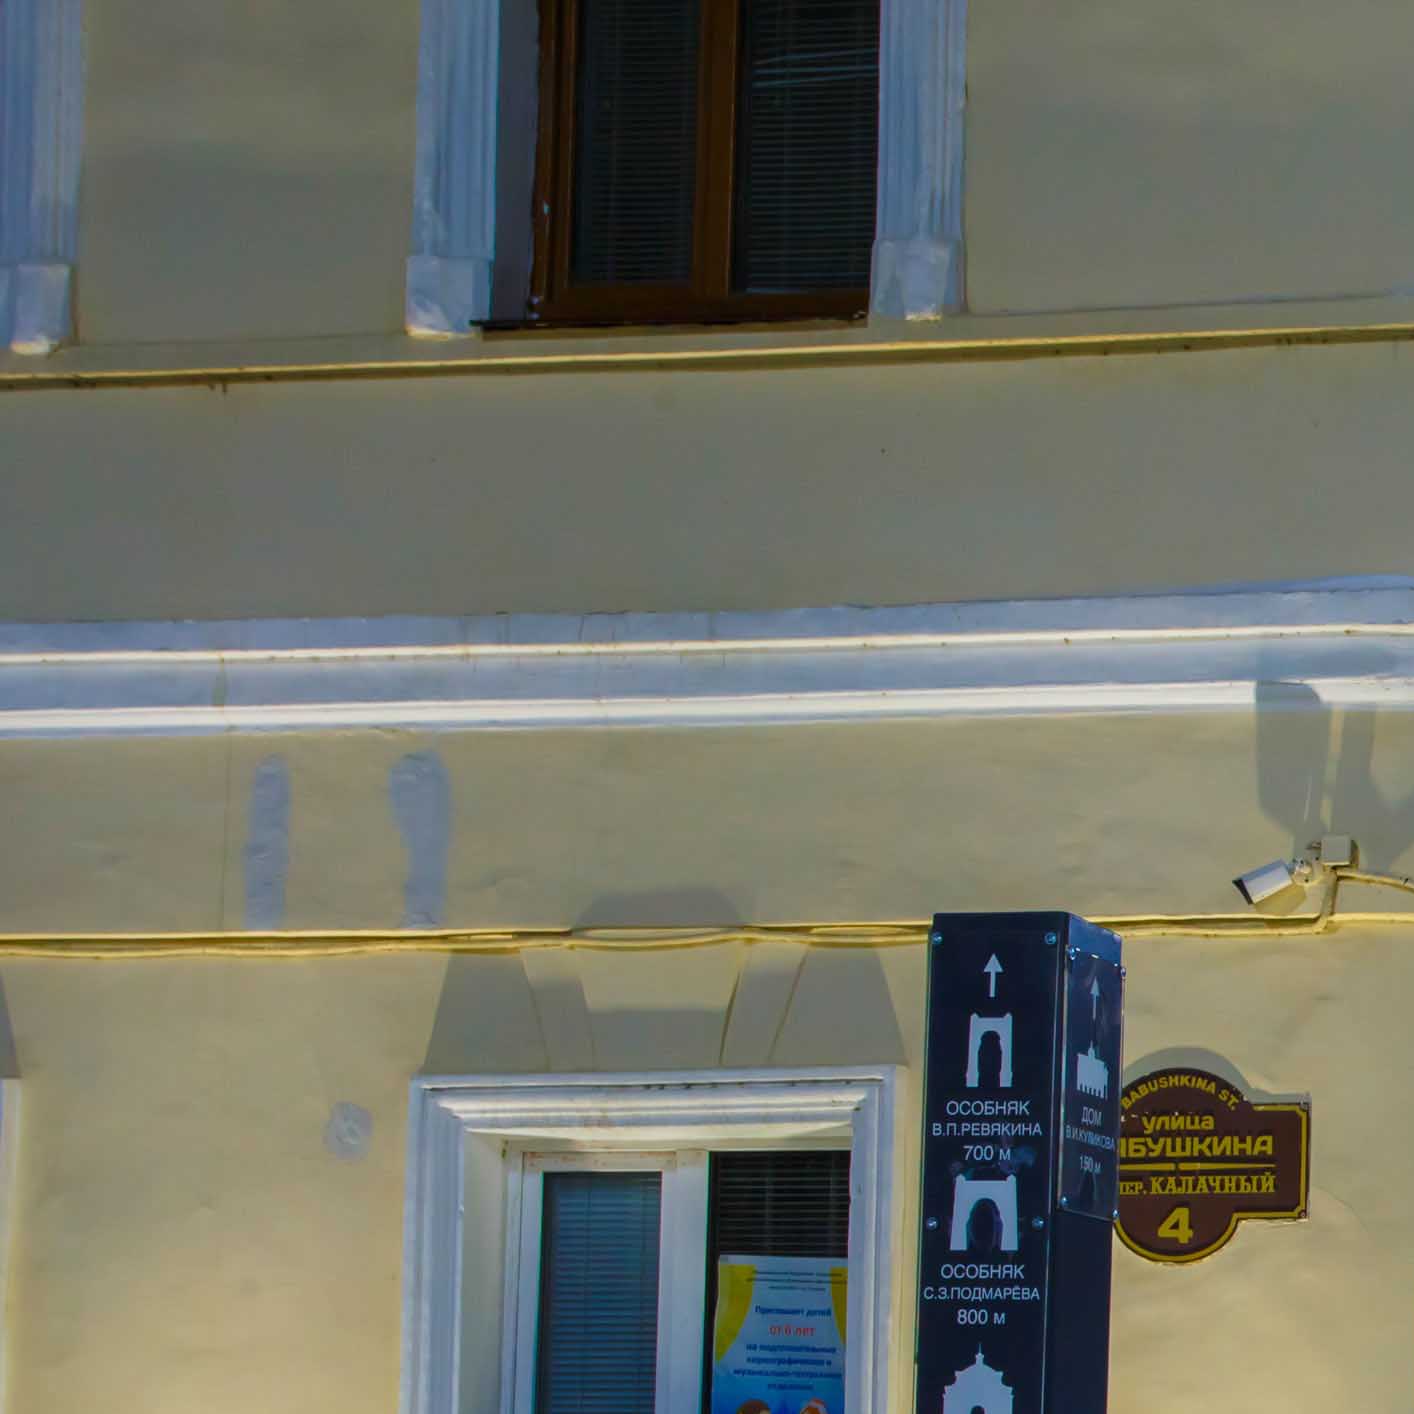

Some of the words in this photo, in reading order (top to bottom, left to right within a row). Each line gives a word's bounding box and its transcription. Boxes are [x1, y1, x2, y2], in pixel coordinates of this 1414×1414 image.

[1120, 1074, 1217, 1110] BABUSHKINA
[1218, 1088, 1240, 1111] ST.
[946, 1100, 1030, 1116] ОСОБНЯК
[1081, 1106, 1103, 1127] ДОМ
[932, 1122, 1042, 1136] В.П.РЕВЯКИНА
[1141, 1114, 1215, 1134] улица
[963, 1145, 994, 1160] 700
[1119, 1135, 1273, 1158] БУШКИНА
[1151, 1172, 1276, 1195] КАЛАЧНЫЙ
[1157, 1207, 1194, 1244] 4
[941, 1263, 1025, 1279] ОСОБНЯК
[957, 1308, 988, 1325] 800
